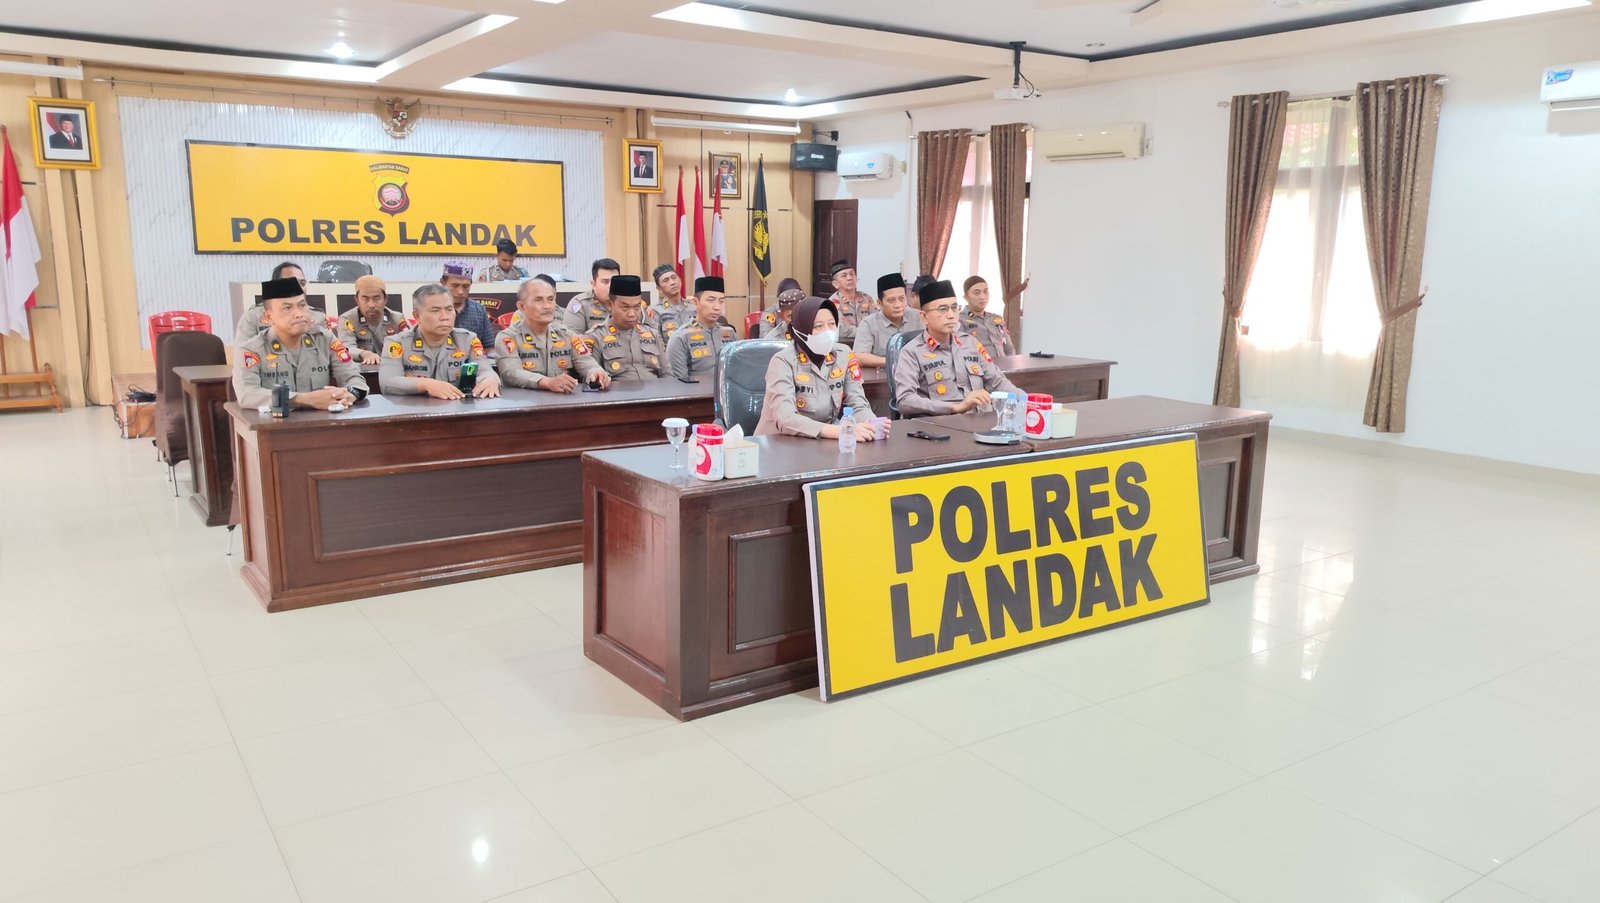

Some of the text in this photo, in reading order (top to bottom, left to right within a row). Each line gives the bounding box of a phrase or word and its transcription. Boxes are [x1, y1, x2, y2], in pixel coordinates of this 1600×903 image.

[230, 217, 538, 247] POLRES LANDAK
[550, 350, 571, 358] POLRI
[603, 341, 621, 349] JOEL
[890, 461, 1151, 574] POLRES
[890, 533, 1163, 663] LANDAK
